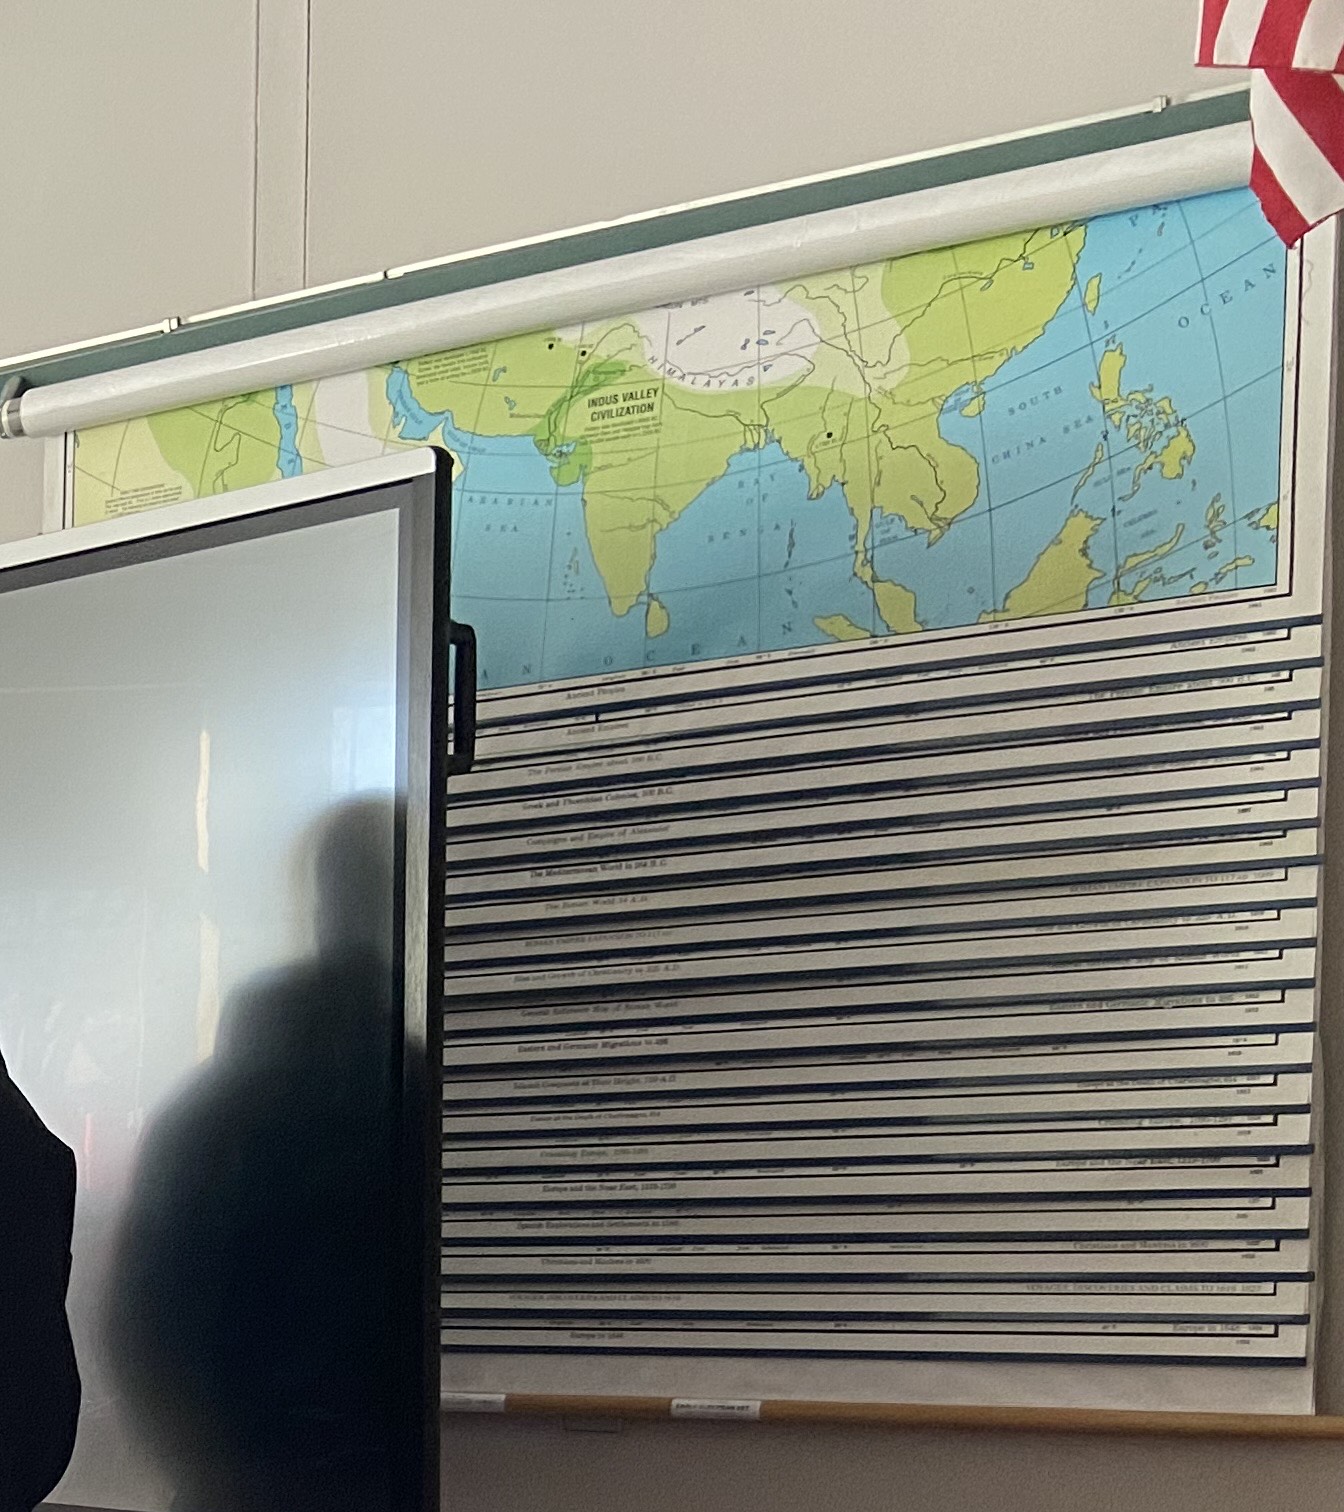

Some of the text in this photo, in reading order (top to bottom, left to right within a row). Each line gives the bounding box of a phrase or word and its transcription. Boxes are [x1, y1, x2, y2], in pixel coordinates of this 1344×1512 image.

[648, 355, 756, 388] HIMALAYAS
[587, 387, 660, 409] INDUS VALLEY
[590, 402, 655, 422] CIVILIZATION
[1008, 386, 1063, 416] SOUTH
[991, 414, 1094, 464] CHINA SEA
